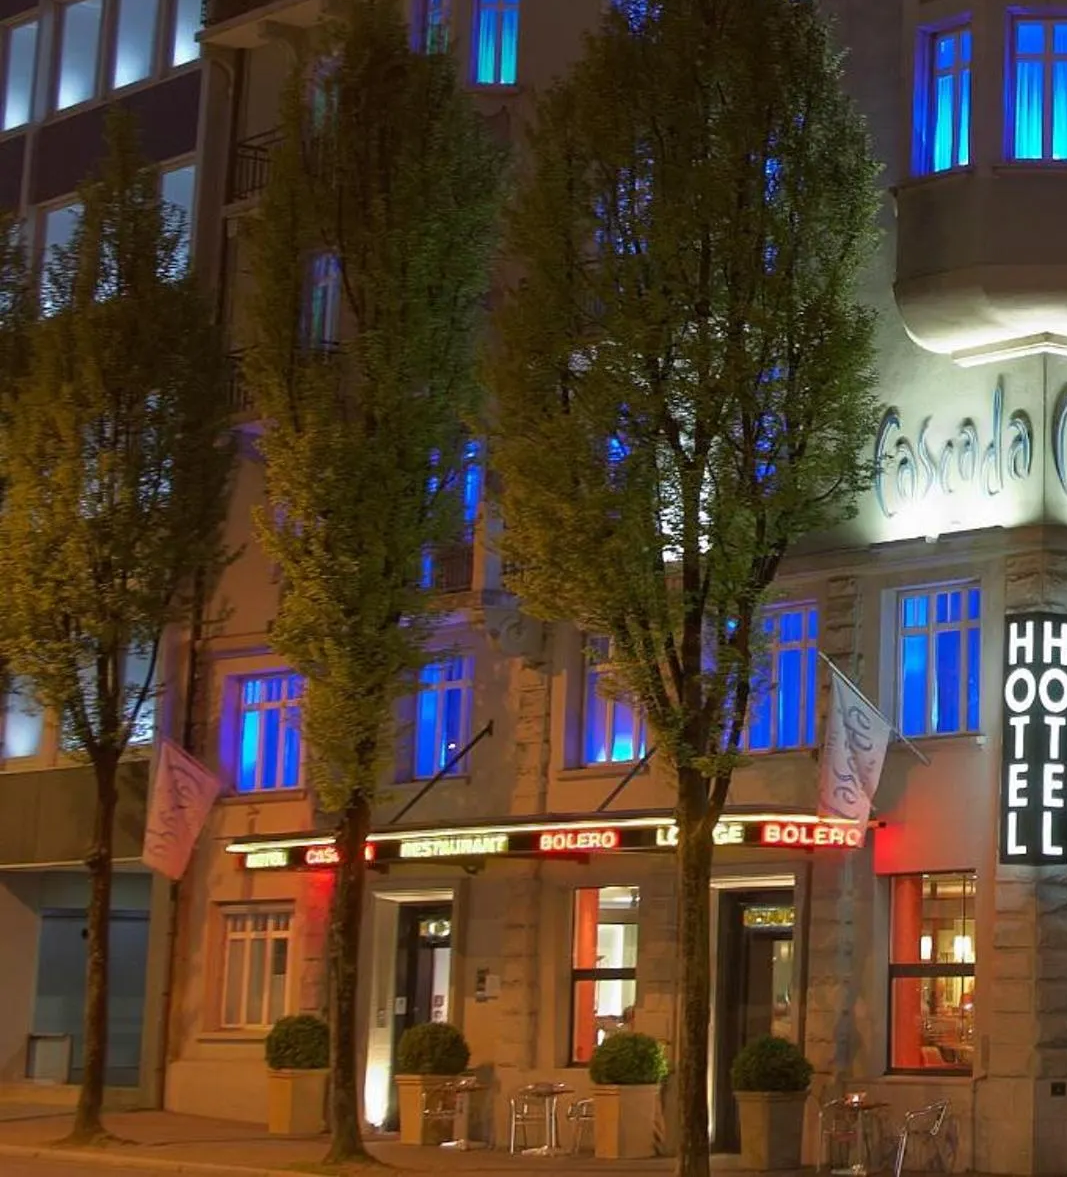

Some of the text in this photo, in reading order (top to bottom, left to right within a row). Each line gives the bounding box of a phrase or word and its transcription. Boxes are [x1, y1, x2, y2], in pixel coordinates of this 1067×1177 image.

[875, 374, 1033, 517] Cascada
[1004, 620, 1036, 855] HOTEL
[539, 828, 617, 851] BOLERO
[656, 823, 744, 846] LOGE
[763, 824, 862, 847] BOLERO
